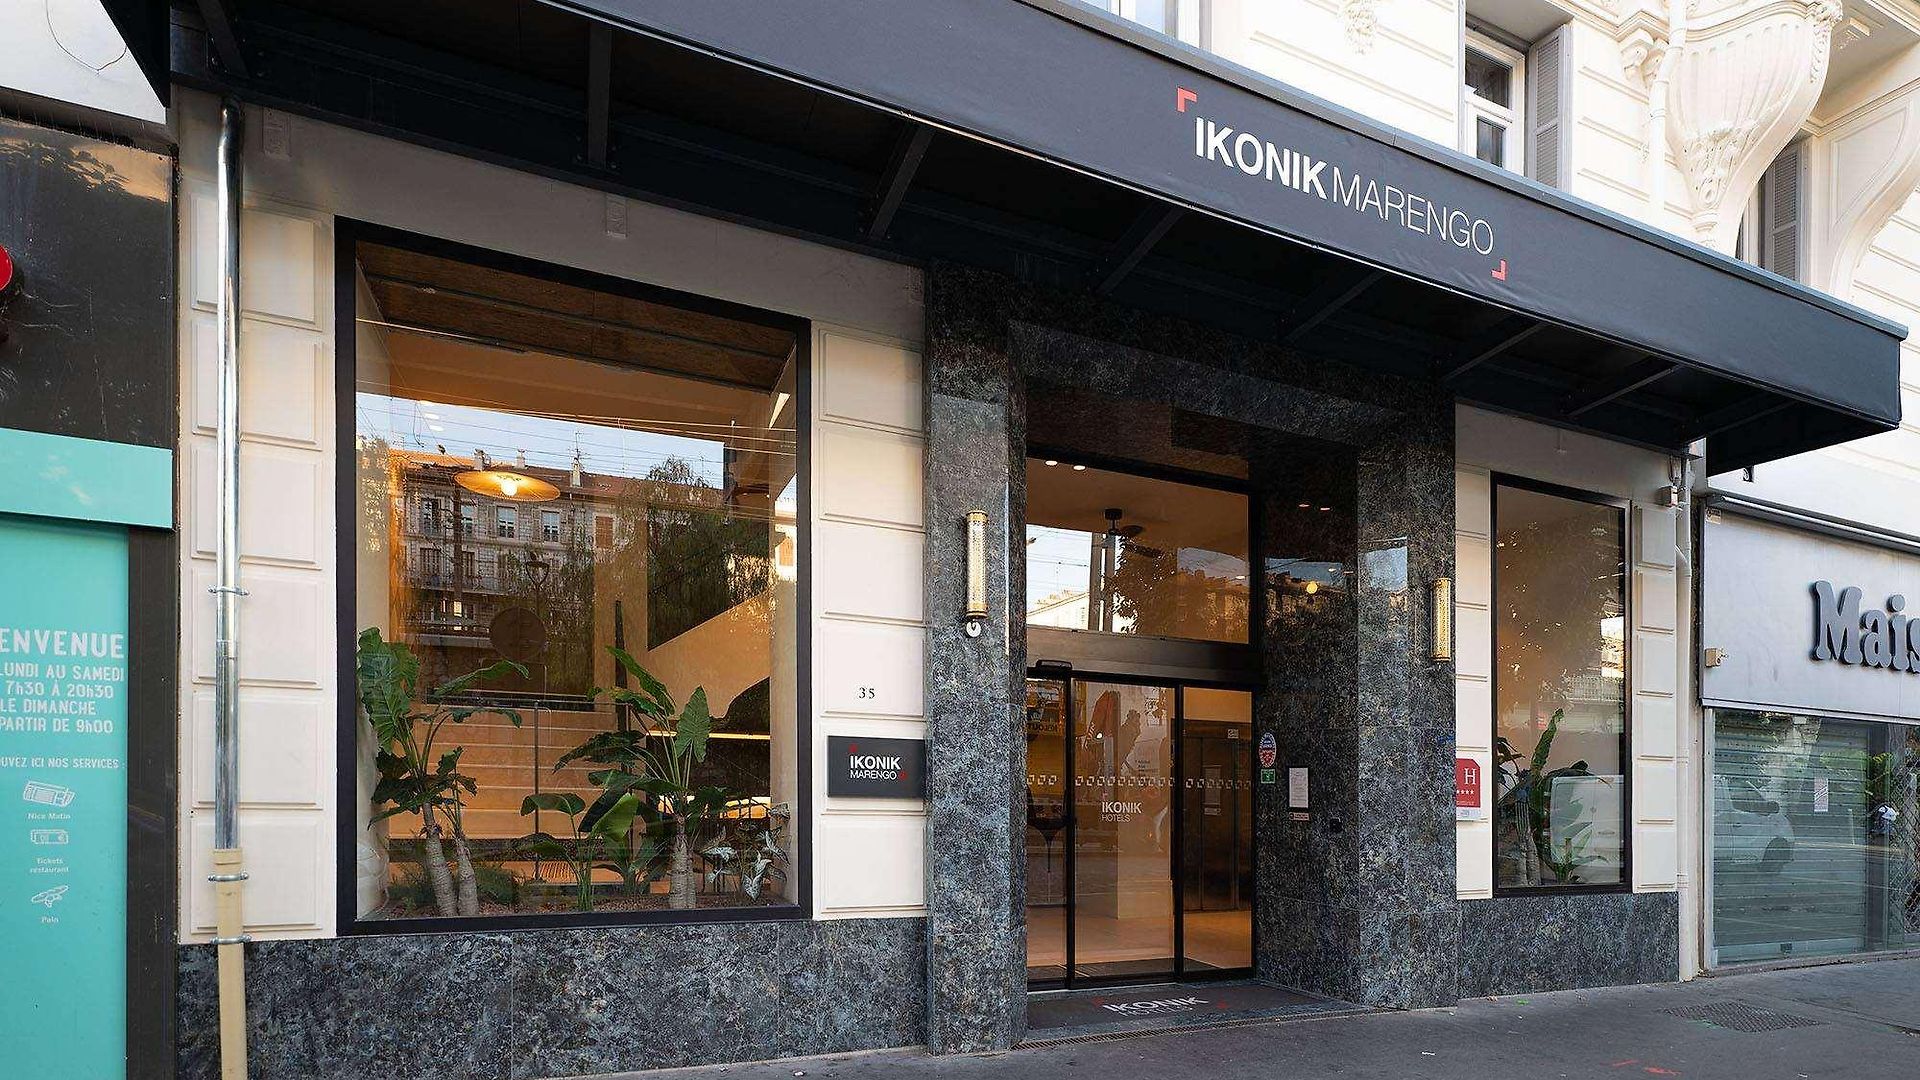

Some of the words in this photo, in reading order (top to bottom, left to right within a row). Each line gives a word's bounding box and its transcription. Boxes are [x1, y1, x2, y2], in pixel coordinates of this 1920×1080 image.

[1195, 117, 1328, 200] IKONIK
[1332, 166, 1495, 255] MARENGO
[46, 664, 66, 679] AU
[72, 665, 125, 682] SAMEDI
[6, 680, 44, 696] 7h30
[51, 678, 60, 697] À
[67, 683, 114, 699] 20h30
[858, 687, 875, 699] 35
[23, 698, 97, 715] DIMANCHE
[52, 718, 70, 733] DE
[76, 719, 114, 734] 9h00
[0, 756, 27, 768] UVEZ
[31, 757, 44, 768] ICI
[47, 757, 69, 768] NOS
[72, 758, 120, 769] SERVICES
[849, 755, 901, 770] IKONIK
[850, 770, 897, 780] MARENGO
[1464, 767, 1477, 786] H
[1101, 801, 1143, 815] IKONIK
[1101, 813, 1131, 823] HOTELS
[1101, 996, 1210, 1013] IKONIK
